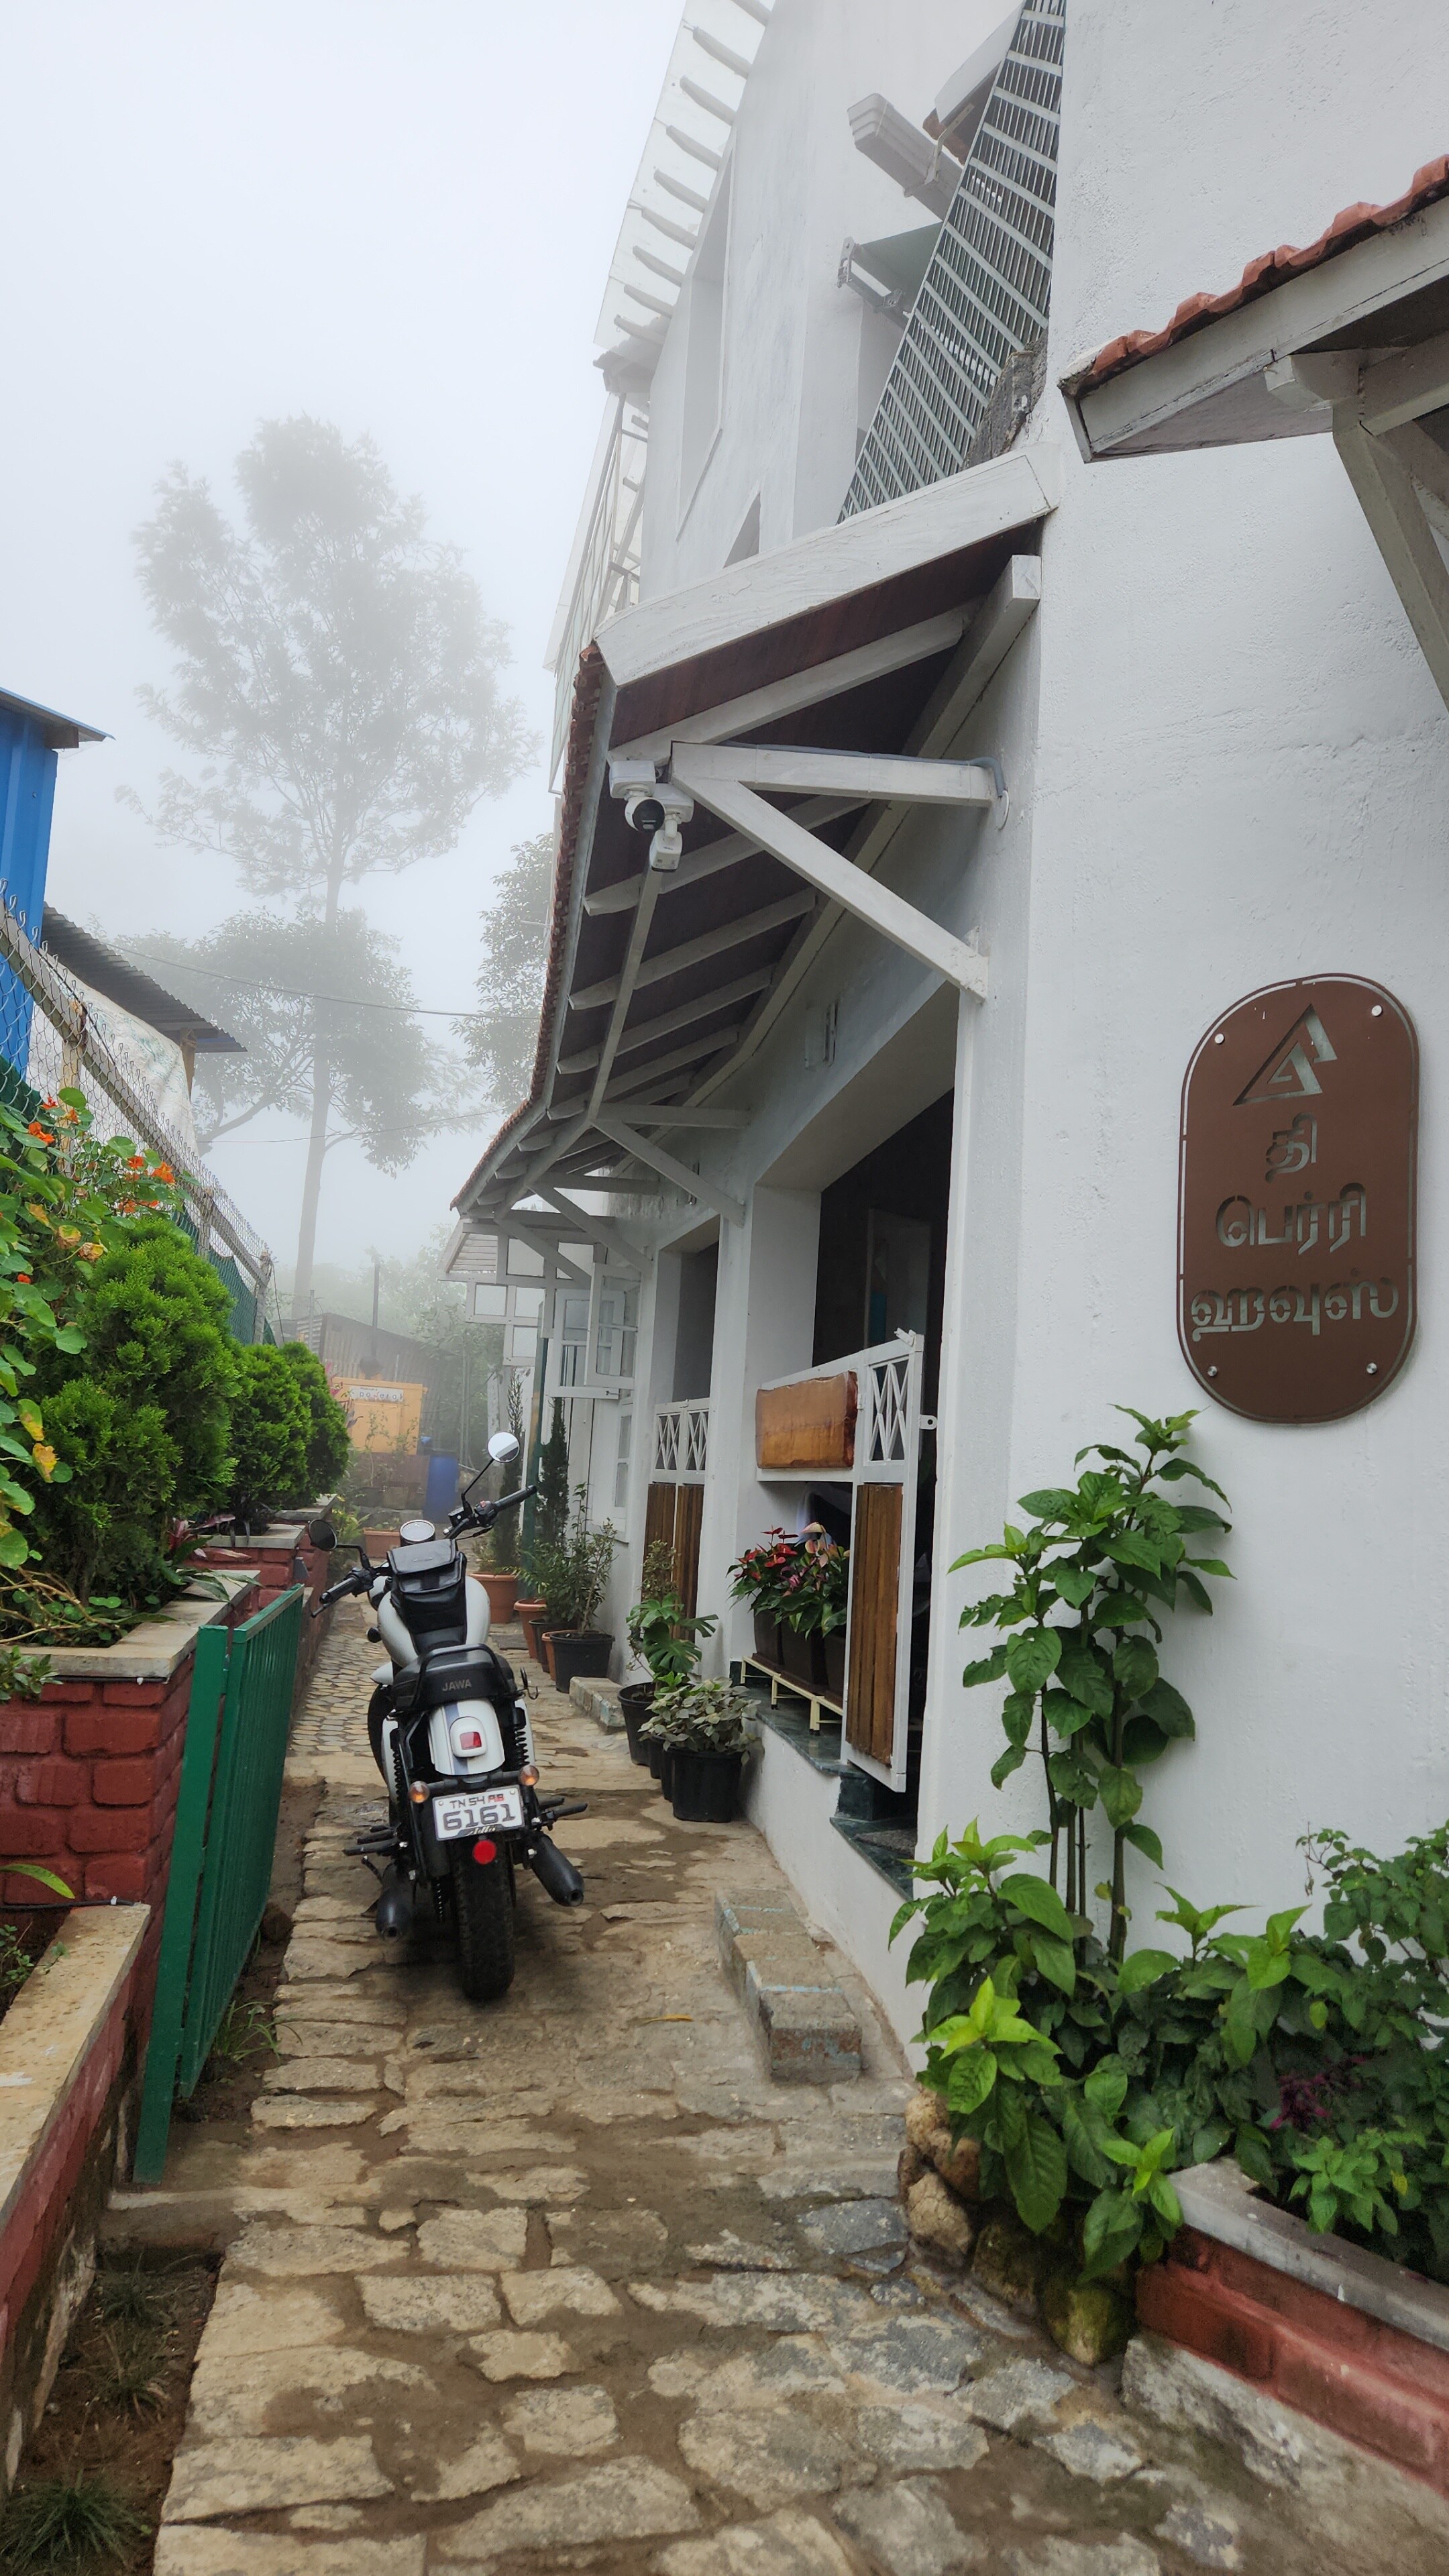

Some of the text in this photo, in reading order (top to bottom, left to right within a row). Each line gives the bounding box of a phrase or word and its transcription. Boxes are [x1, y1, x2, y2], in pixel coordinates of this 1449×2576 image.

[1265, 1112, 1318, 1183] தி
[1216, 1181, 1366, 1254] பெர்ரி
[1191, 1267, 1400, 1342] ஹவுஸ்
[442, 1679, 472, 1691] JAWA
[443, 1804, 515, 1831] 6161
[449, 1799, 466, 1809] TN
[468, 1796, 485, 1806] 54
